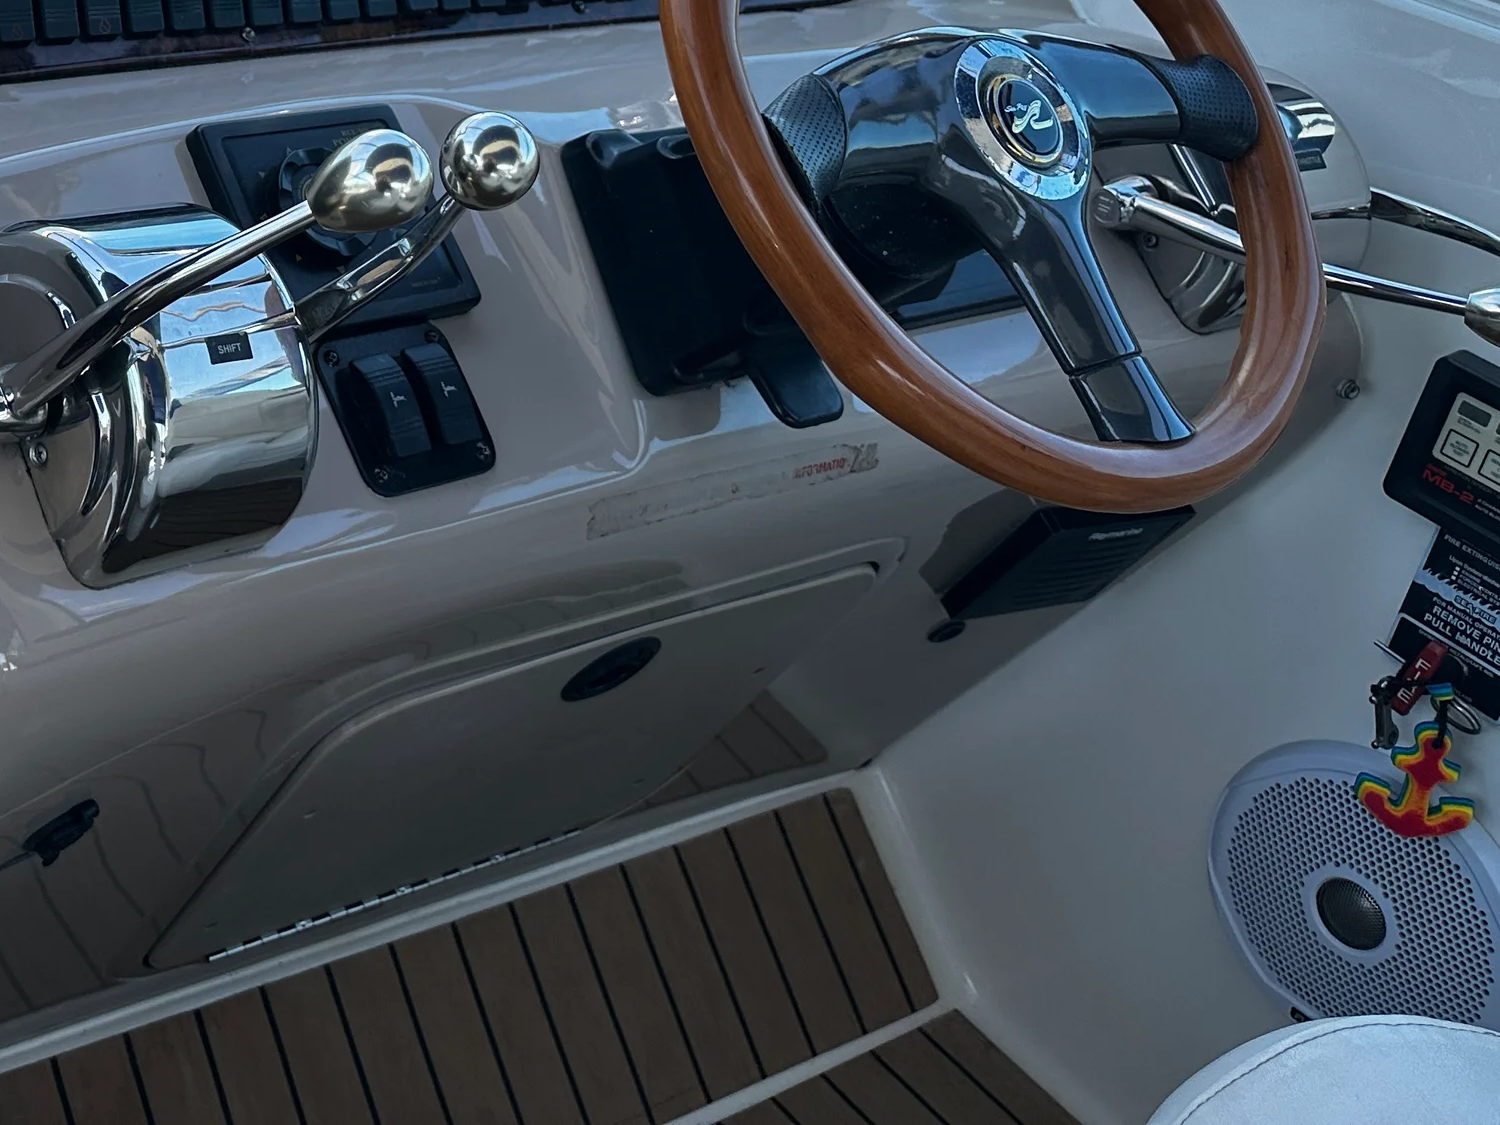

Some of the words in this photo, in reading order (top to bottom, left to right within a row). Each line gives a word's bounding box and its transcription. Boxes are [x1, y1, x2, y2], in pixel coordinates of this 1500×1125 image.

[217, 342, 241, 355] SHIFT
[1444, 534, 1461, 547] FIRE
[1433, 596, 1446, 607] FOR
[1448, 604, 1473, 623] MANUAL
[1423, 612, 1452, 636] PULL
[1432, 605, 1483, 640] REMOVE
